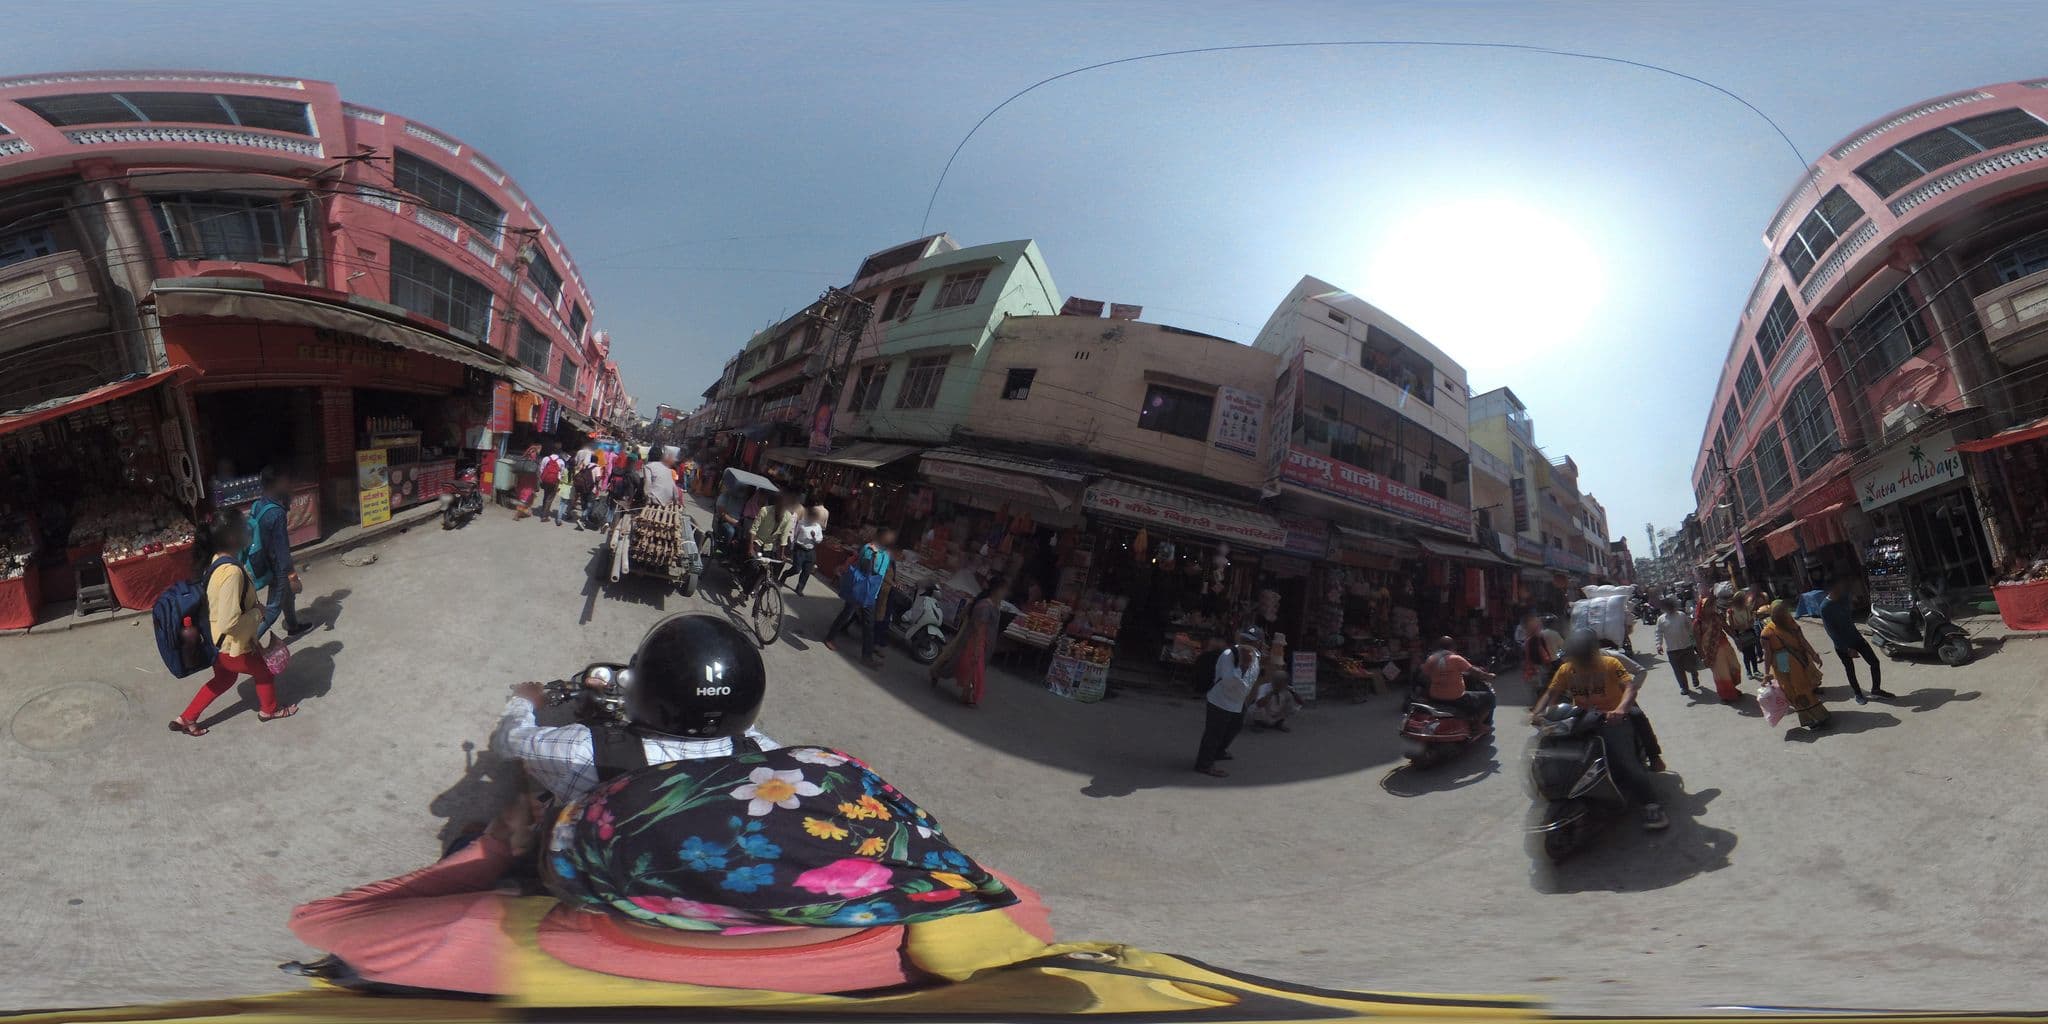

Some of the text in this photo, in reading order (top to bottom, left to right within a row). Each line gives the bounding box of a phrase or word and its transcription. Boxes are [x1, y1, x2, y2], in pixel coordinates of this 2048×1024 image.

[1287, 449, 1334, 481] जम्मू
[1339, 465, 1382, 491] वाली
[1386, 483, 1439, 510] धर्मशाला
[1897, 453, 1960, 489] Holidays
[1099, 496, 1121, 508] श्री
[1163, 509, 1211, 528] बिहारी
